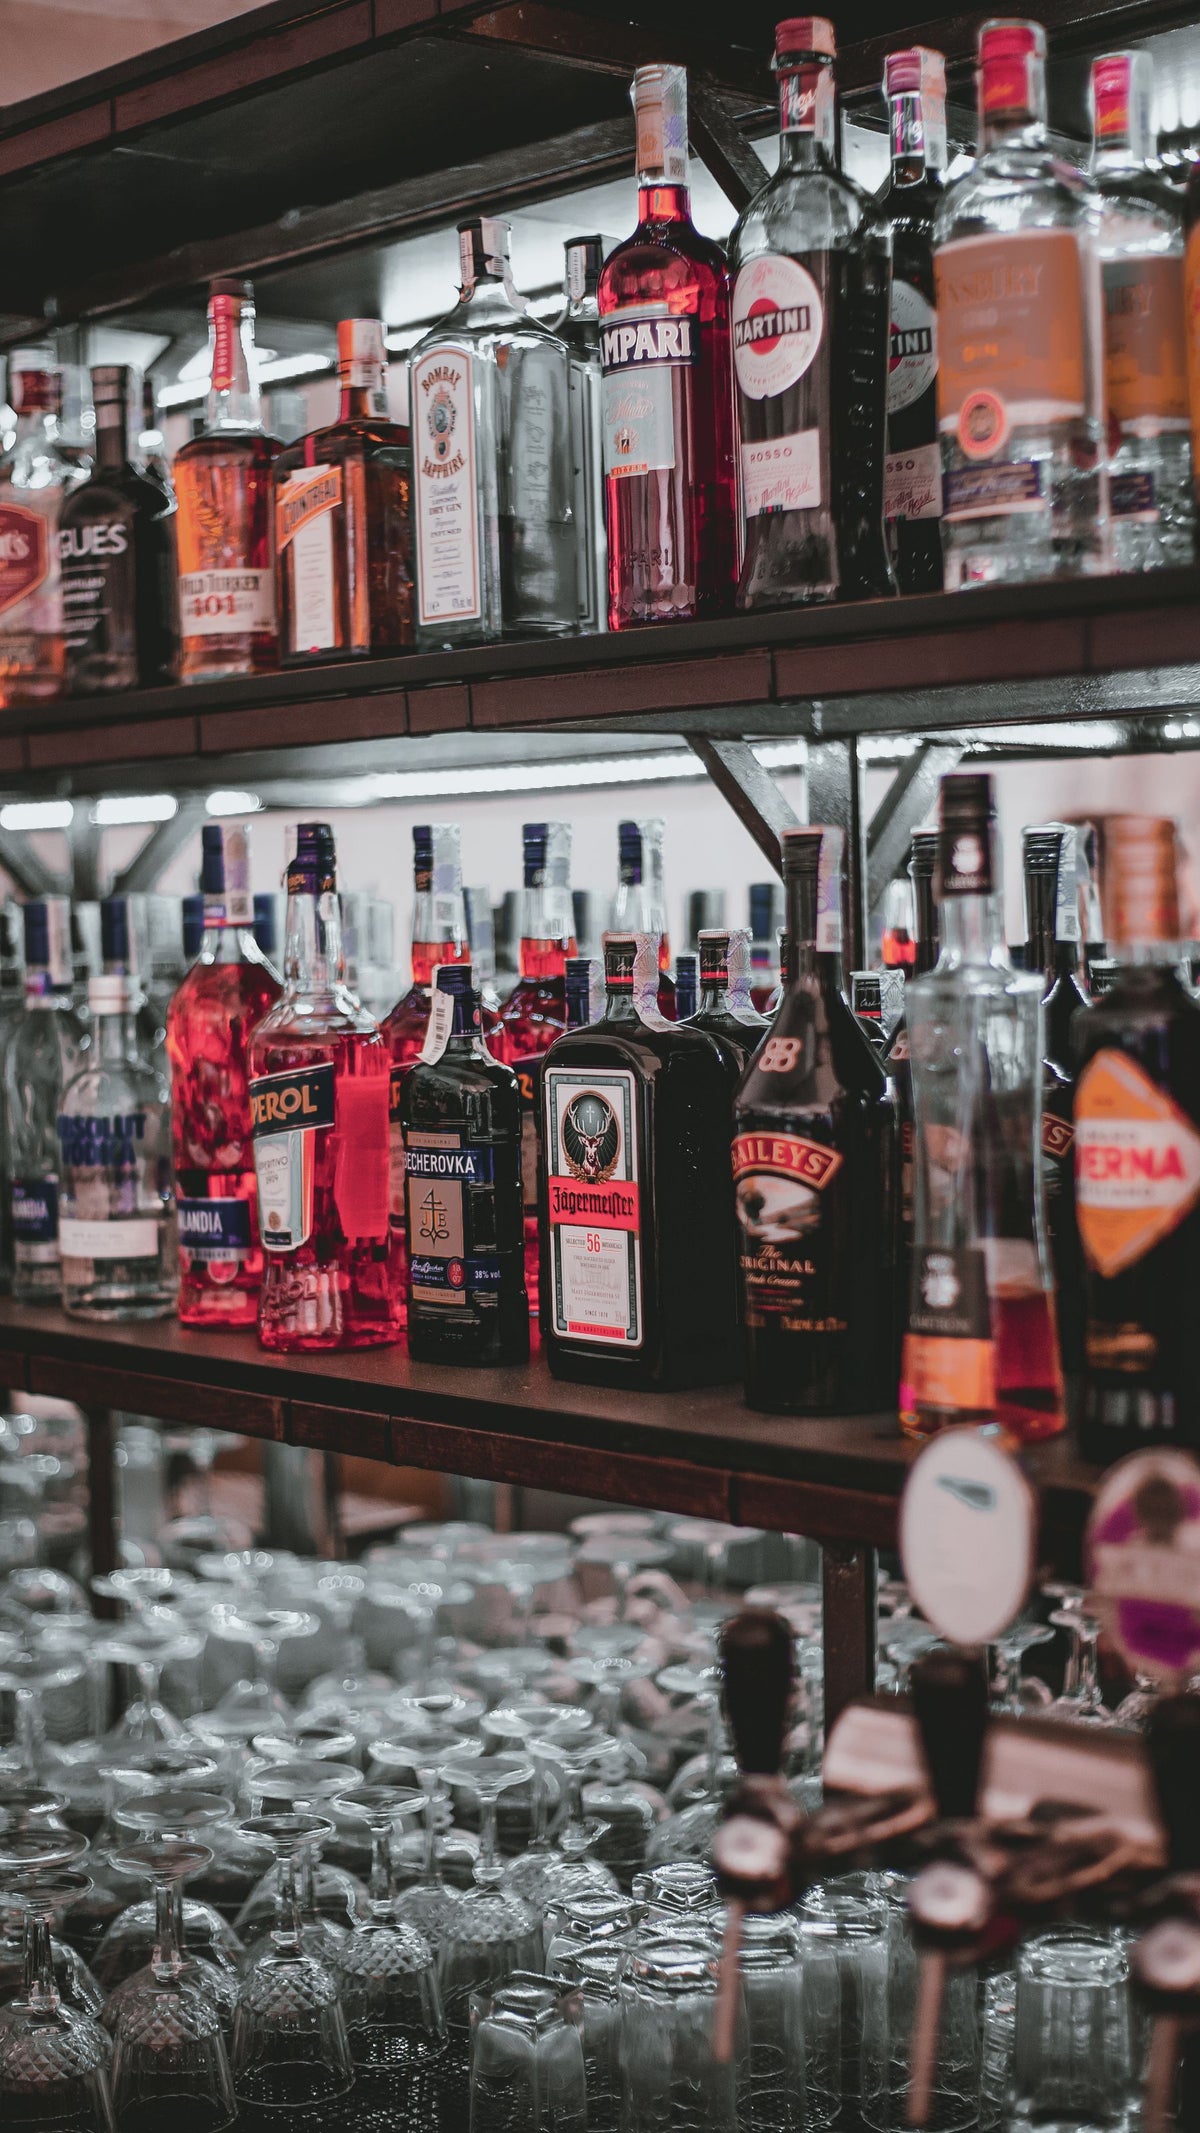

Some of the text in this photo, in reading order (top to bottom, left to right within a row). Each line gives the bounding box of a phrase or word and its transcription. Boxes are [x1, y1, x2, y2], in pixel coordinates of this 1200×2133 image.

[735, 306, 809, 347] MARTINI
[421, 365, 462, 393] BOMBAY
[422, 452, 466, 479] SAPPHIRE
[750, 447, 792, 464] ROSSO
[404, 1151, 476, 1174] BECHEROVKA
[731, 1139, 824, 1175] BAILEYS
[586, 1232, 601, 1253] 56
[474, 1270, 490, 1279] 38%
